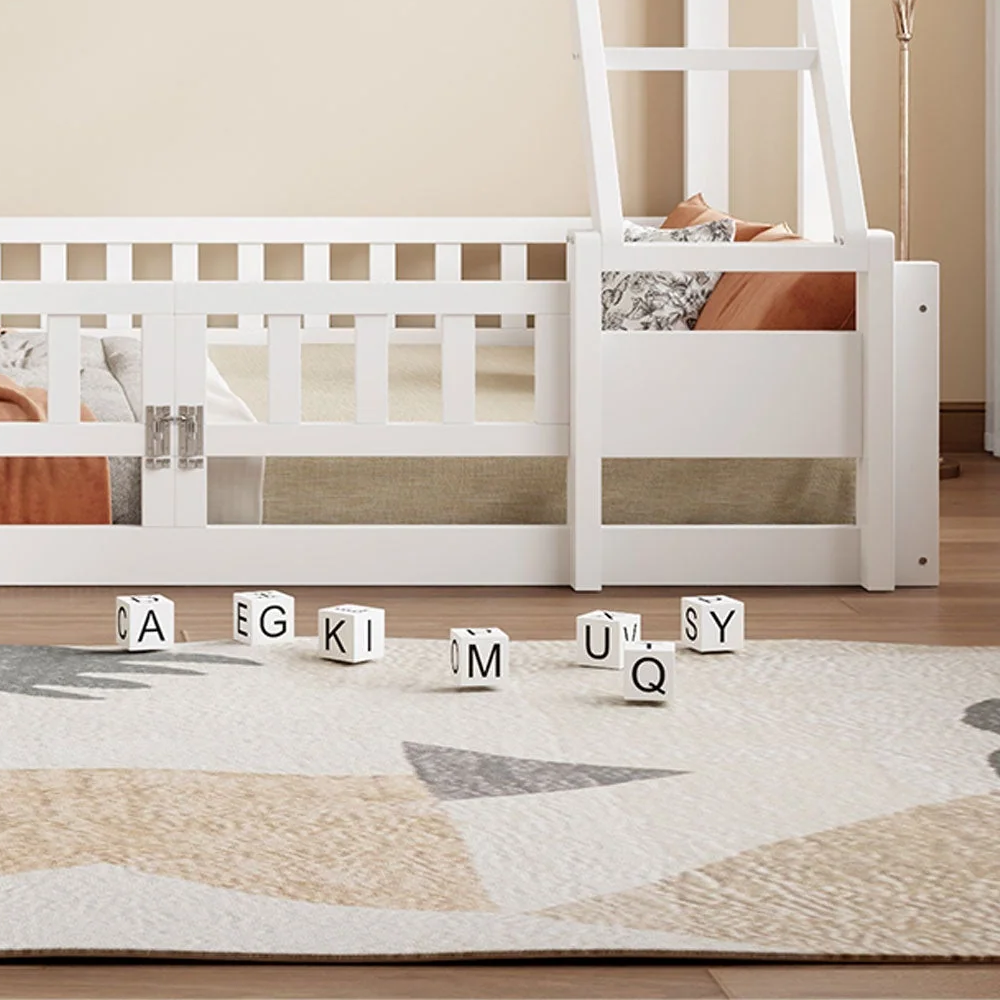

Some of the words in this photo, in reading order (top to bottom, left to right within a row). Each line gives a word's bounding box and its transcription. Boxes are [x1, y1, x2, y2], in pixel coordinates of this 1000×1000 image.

[137, 609, 166, 642] A
[259, 604, 287, 638] G
[325, 617, 347, 654] K
[709, 609, 736, 643] Y
[585, 624, 610, 660] U
[468, 643, 501, 678] M
[631, 656, 666, 695] Q
